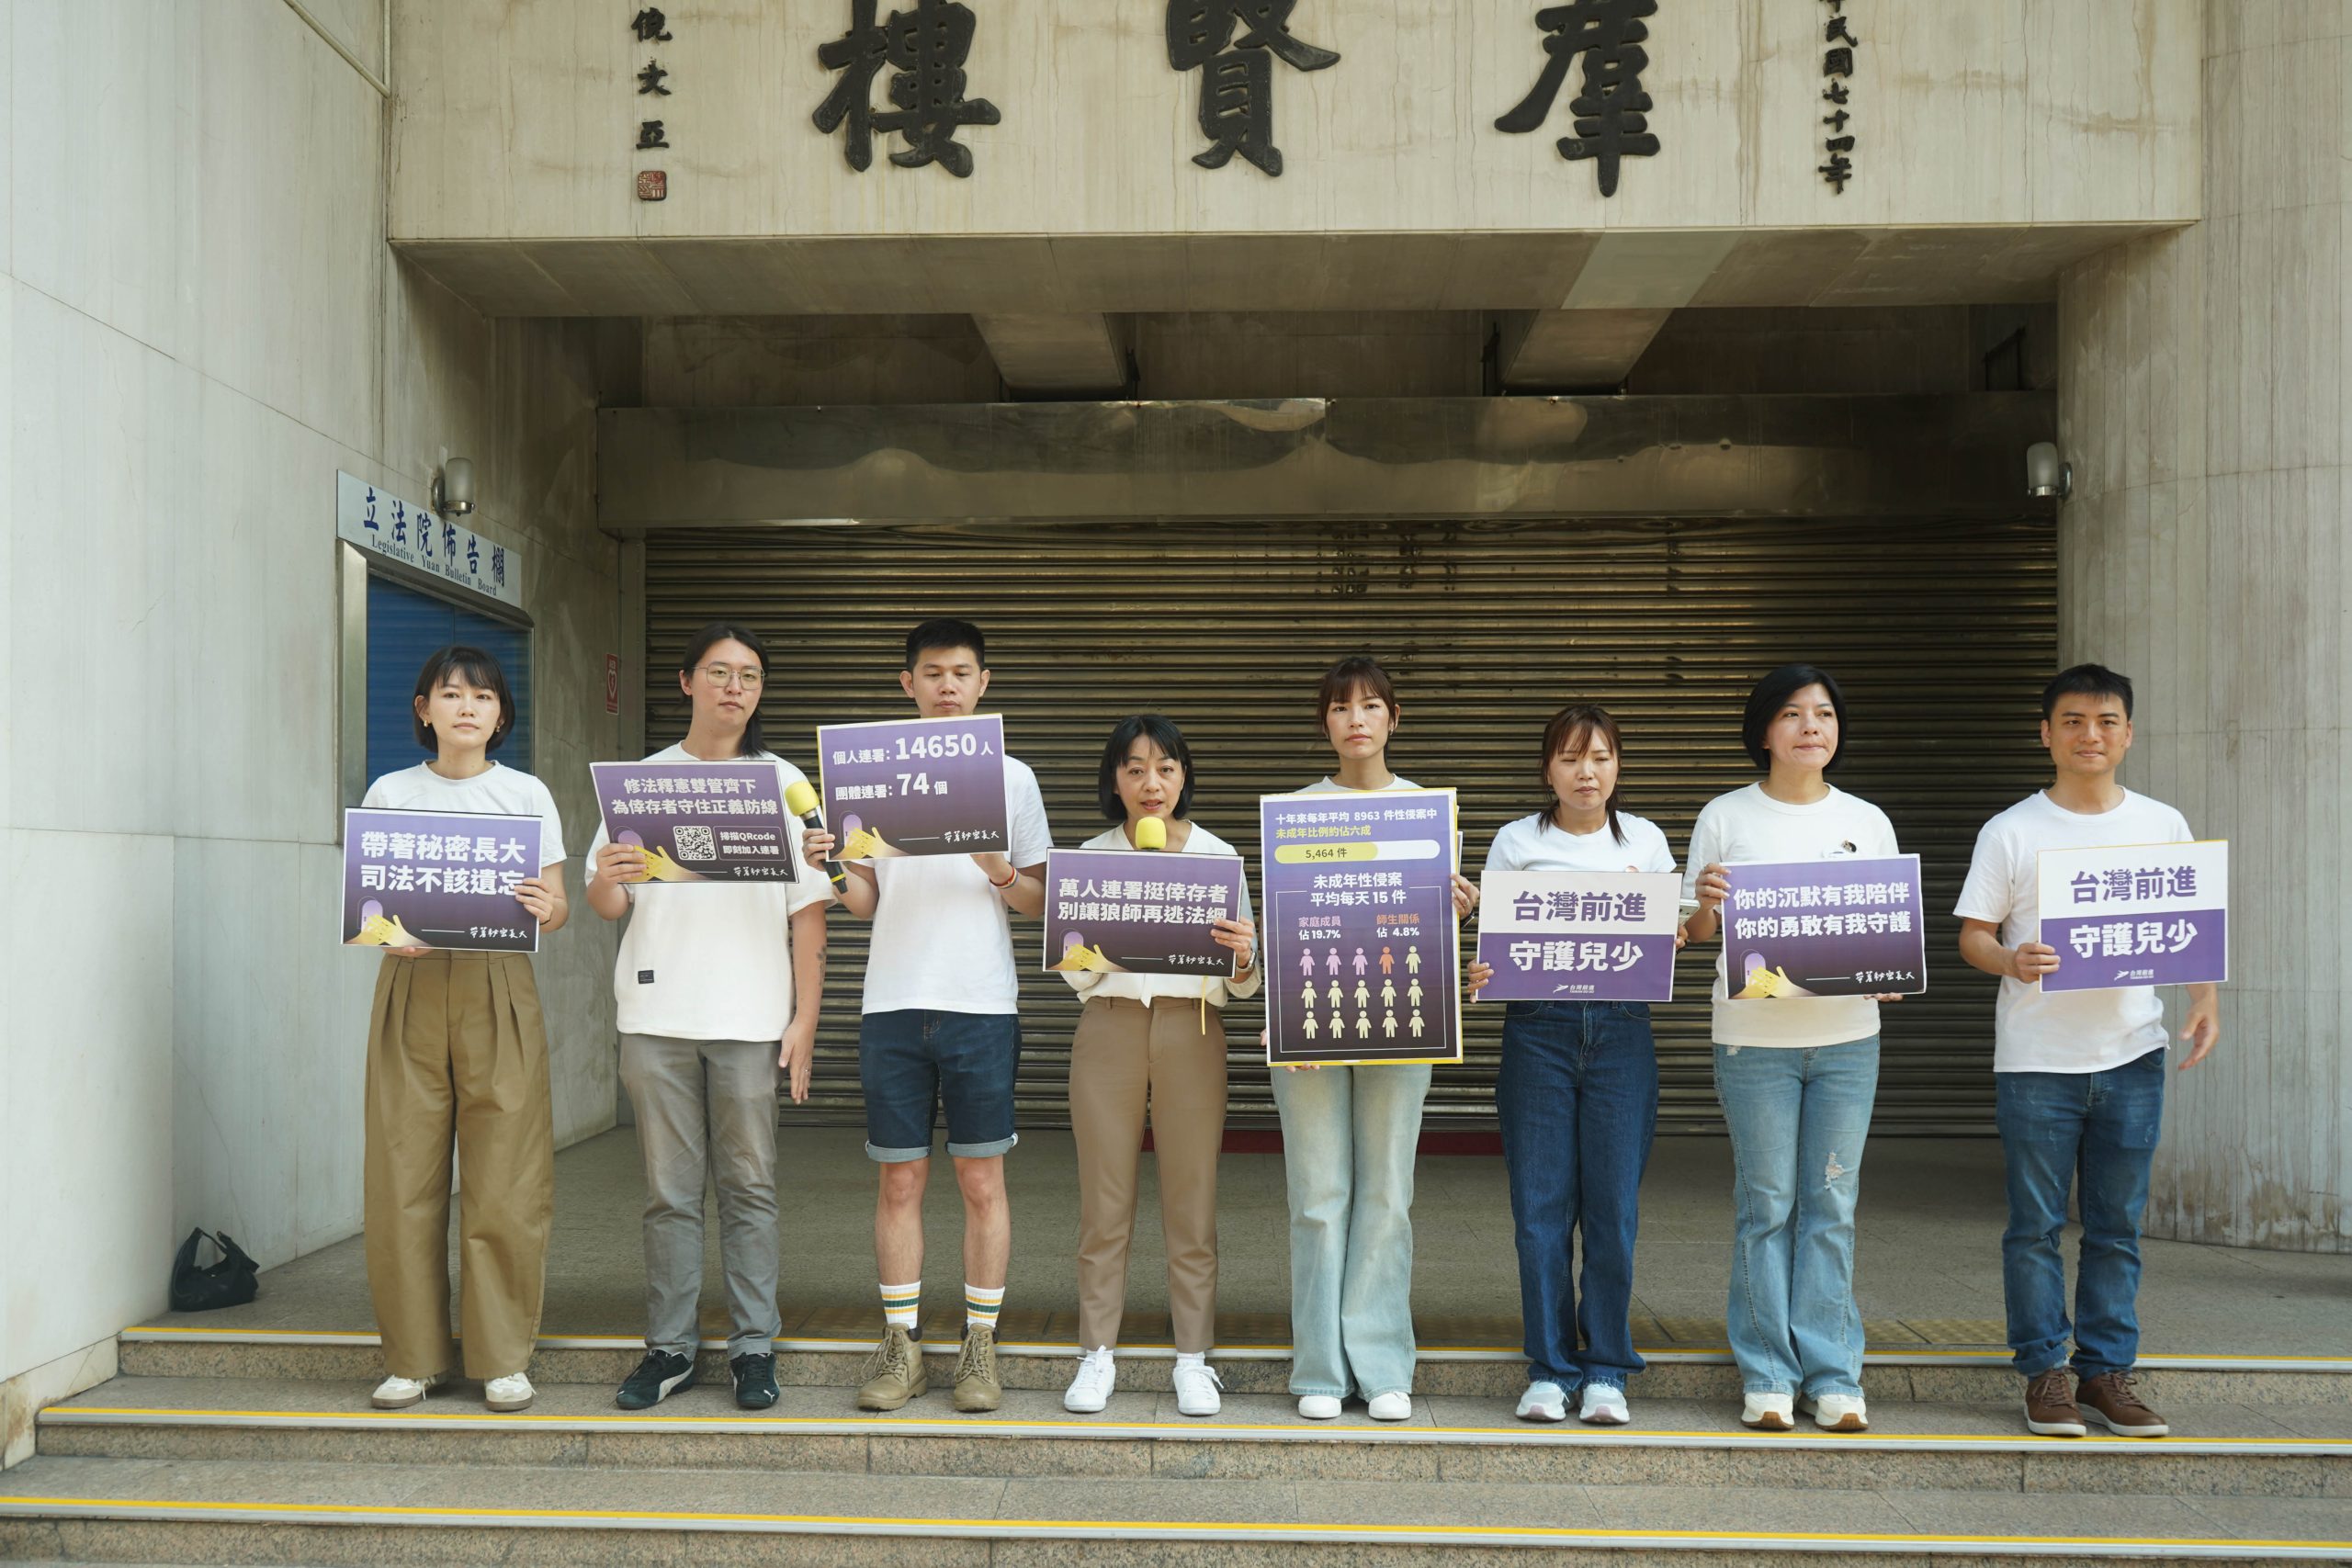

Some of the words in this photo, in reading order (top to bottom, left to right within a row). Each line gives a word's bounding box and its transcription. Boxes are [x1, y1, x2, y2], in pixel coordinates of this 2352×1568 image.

[363, 486, 505, 589] 立法院佈告欄
[371, 534, 414, 563] Legislative
[422, 557, 440, 574] Yuan
[445, 563, 471, 586] Bulletin
[478, 575, 497, 596] Board
[895, 733, 977, 761] 14650
[980, 740, 994, 756] 人
[623, 778, 756, 795] 修法釋憲雙管齊下
[897, 772, 930, 796] 74
[933, 781, 948, 796] 個
[611, 799, 778, 816] 為倖存者守住正義防線
[1354, 811, 1380, 822] 8963
[361, 831, 526, 864] 帶著秘密長大
[1306, 849, 1333, 860] 5,464
[1337, 847, 1348, 858] 件
[360, 864, 525, 896] 司法不該遺忘
[1058, 878, 1228, 904] 萬人連署挺倖存者
[1313, 872, 1403, 889] 未成年性侵案
[2070, 865, 2197, 904] 台灣前進
[1513, 891, 1646, 921] 台灣前進
[1733, 882, 1910, 910] 你的沉默有我陪伴
[1057, 901, 1227, 925] 別讓狼師再逃法網
[1298, 916, 1341, 928] 家庭成員
[1376, 913, 1420, 926] 師生關係
[1735, 911, 1912, 940] 你的勇敢有我守護
[1311, 929, 1341, 939] 19.7%
[1392, 926, 1420, 937] 4.8%
[2070, 919, 2199, 958] 守護兒少
[1509, 941, 1644, 972] 守護兒少
